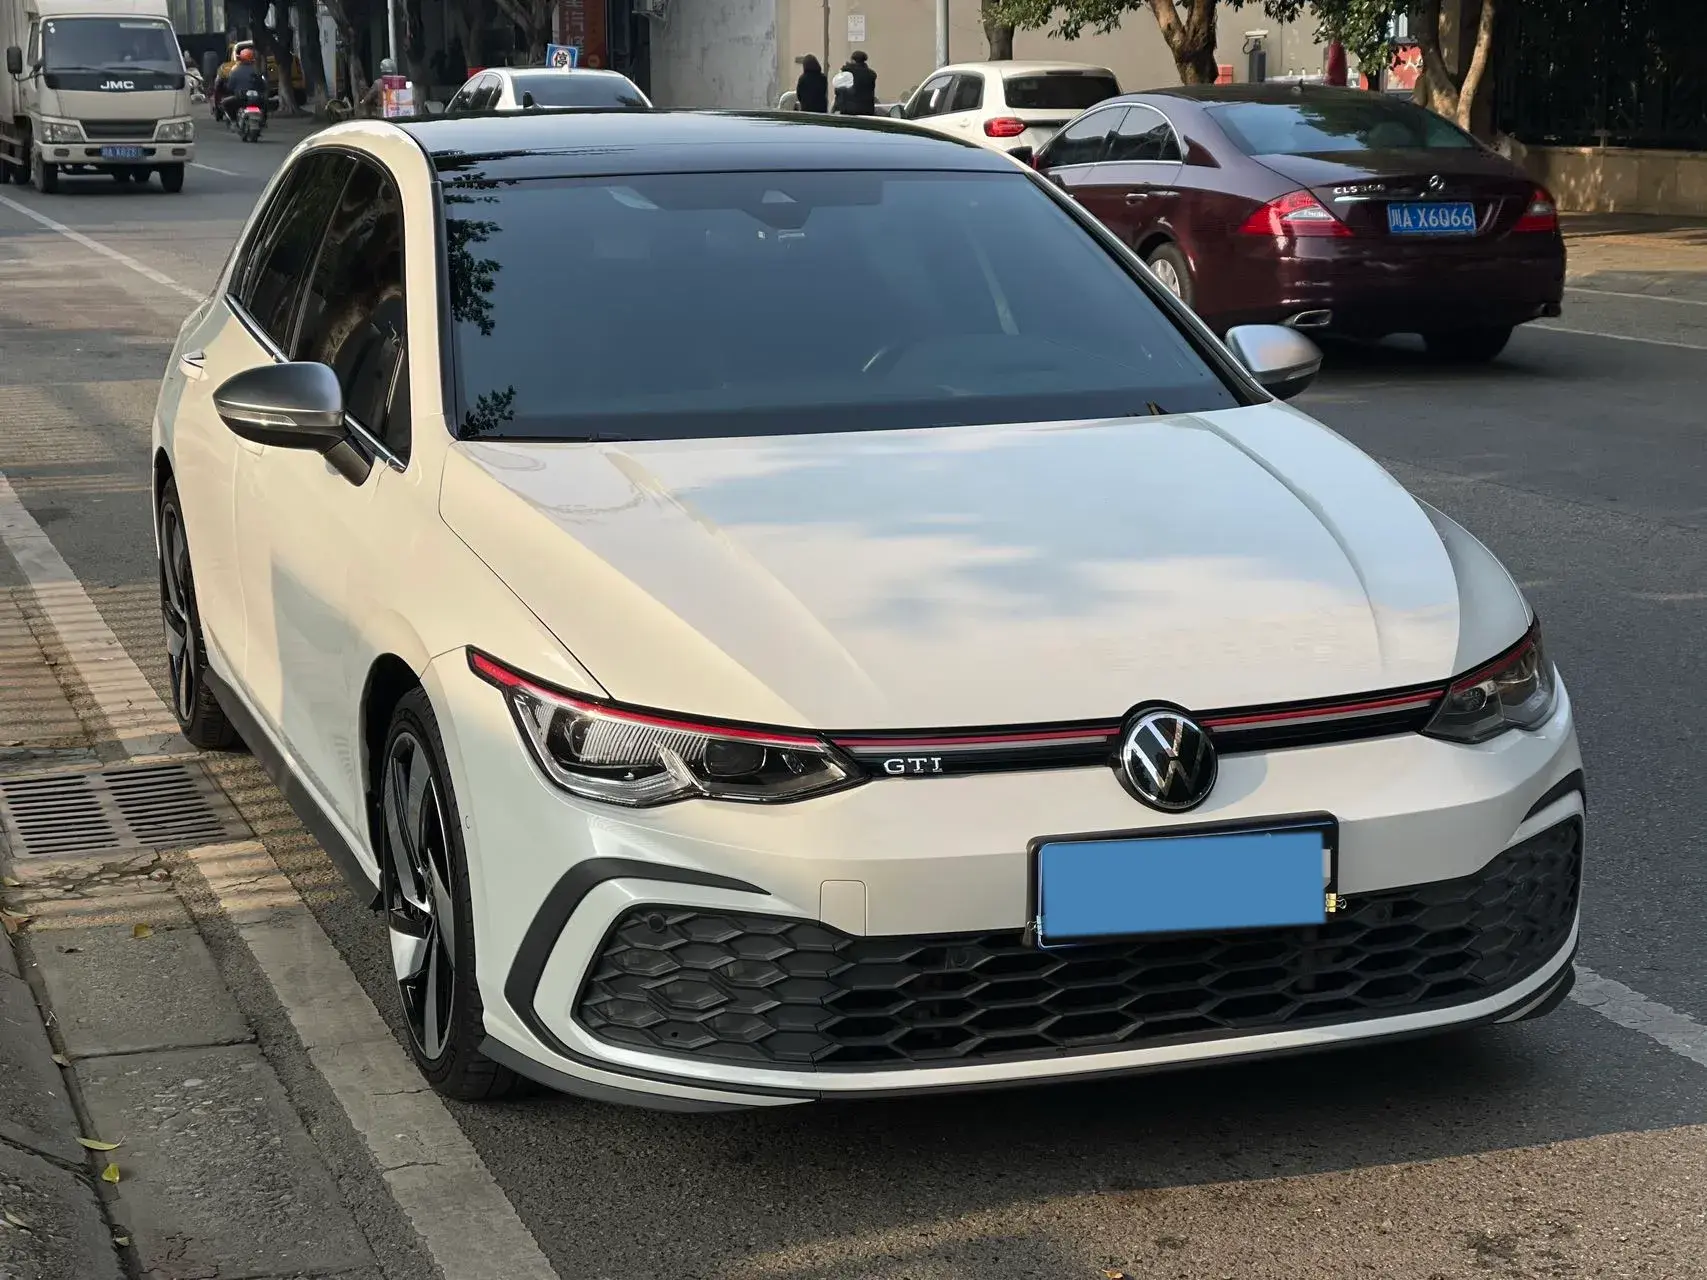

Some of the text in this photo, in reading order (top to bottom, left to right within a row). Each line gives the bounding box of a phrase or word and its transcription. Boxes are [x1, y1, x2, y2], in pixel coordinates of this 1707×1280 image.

[554, 51, 568, 68] 停
[100, 80, 135, 89] JMC
[1333, 185, 1358, 195] CLS
[883, 756, 944, 775] GTI
